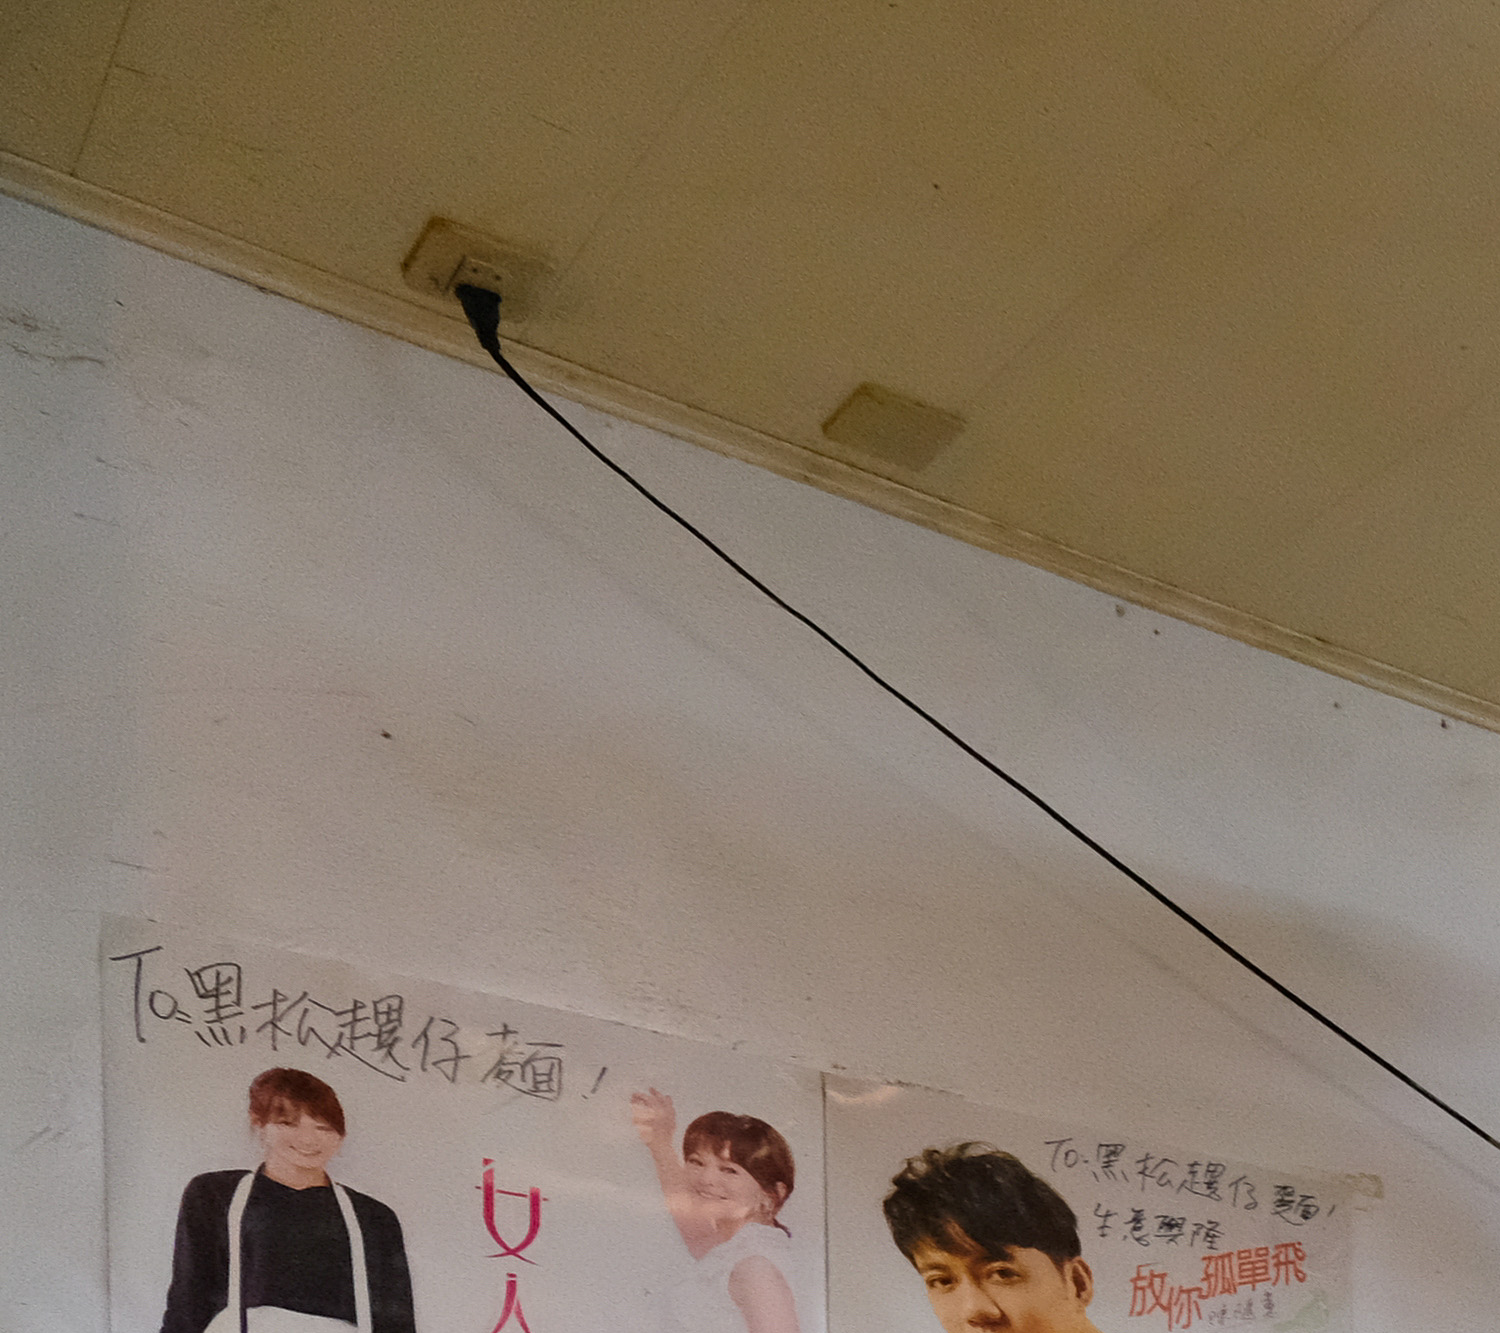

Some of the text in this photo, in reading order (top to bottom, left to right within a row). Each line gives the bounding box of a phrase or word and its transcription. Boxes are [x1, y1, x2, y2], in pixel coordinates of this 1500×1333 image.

[1129, 1241, 1308, 1332] 放你孤單飛
